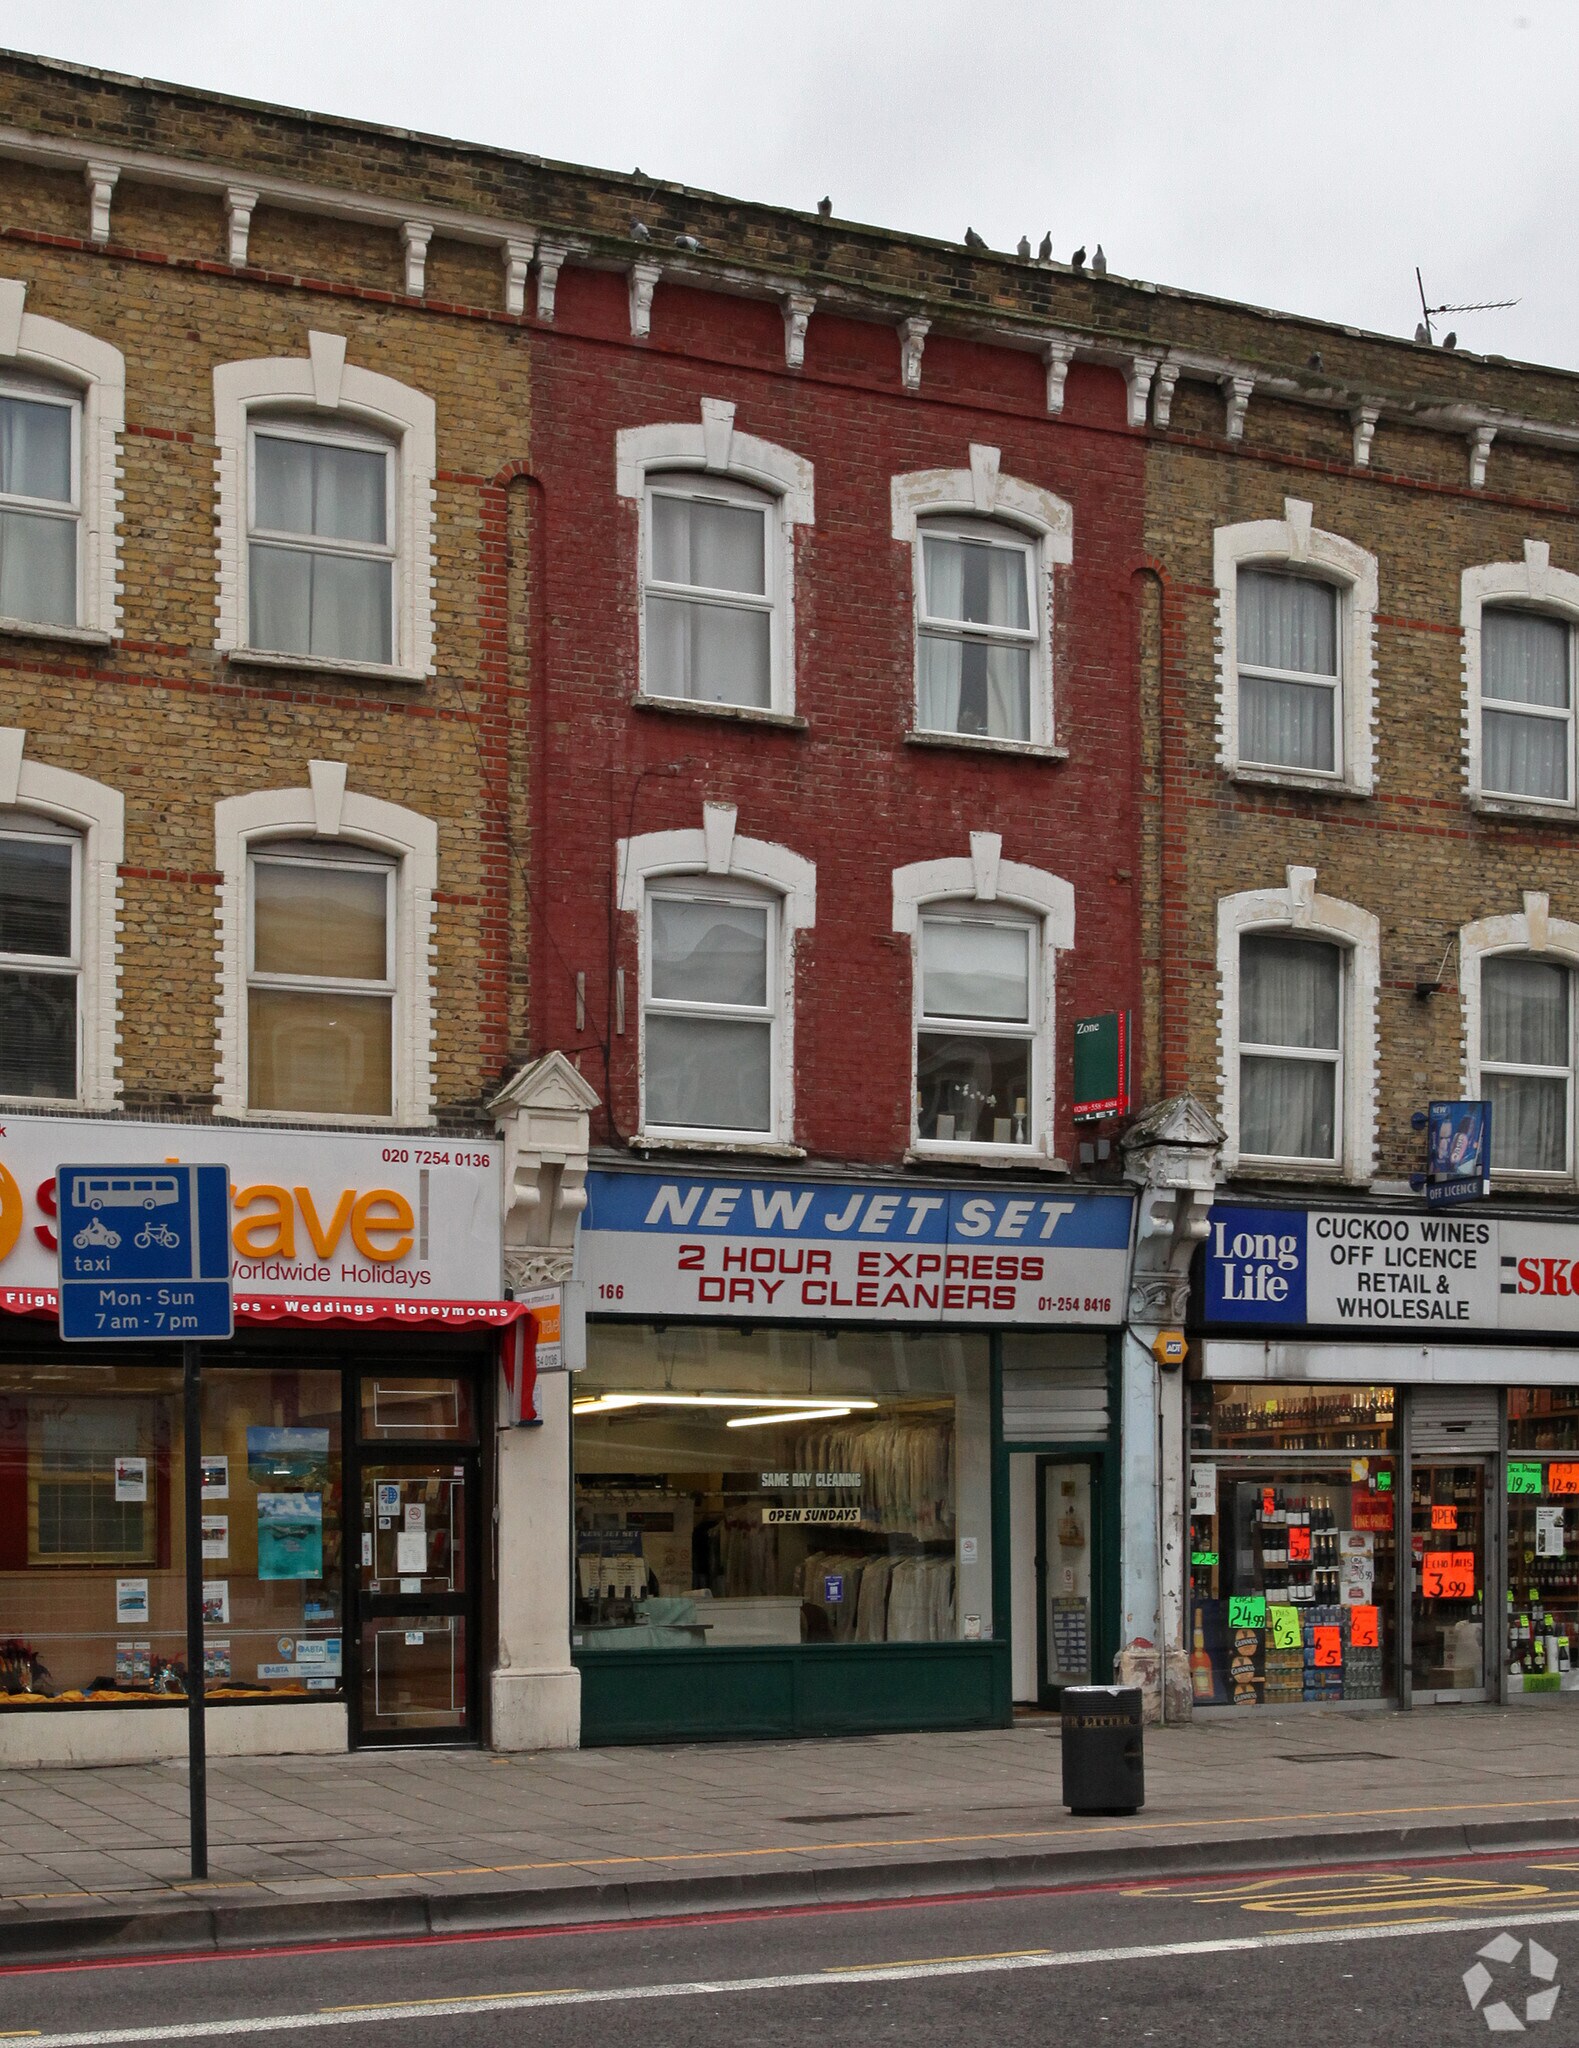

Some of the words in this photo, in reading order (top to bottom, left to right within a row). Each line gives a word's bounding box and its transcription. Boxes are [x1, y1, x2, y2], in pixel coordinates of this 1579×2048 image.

[1076, 1023, 1100, 1034] Zone
[1086, 1110, 1116, 1120] LET
[382, 1149, 409, 1163] 020
[415, 1150, 450, 1165] 7254
[455, 1154, 490, 1168] 0136
[1430, 1188, 1442, 1200] OFF
[1444, 1182, 1477, 1197] LICENCE
[644, 1184, 816, 1230] NEW
[825, 1194, 940, 1235] JET
[954, 1199, 1076, 1240] SET
[1316, 1218, 1409, 1242] CUCKOO
[1420, 1222, 1490, 1244] WINES
[1212, 1222, 1298, 1271] Long
[74, 1256, 111, 1272] taxi
[677, 1245, 705, 1270] 2
[722, 1246, 832, 1276] HOUR
[858, 1252, 1044, 1281] EXPRESS
[1330, 1244, 1373, 1267] OFF
[1384, 1247, 1477, 1270] LICENCE
[231, 1261, 331, 1282] orldwide
[341, 1265, 431, 1288] Holidays
[1222, 1262, 1288, 1302] Life
[1358, 1272, 1430, 1294] RETAIL
[1436, 1274, 1450, 1294] &
[100, 1290, 141, 1306] Mon
[158, 1290, 194, 1306] Sun
[598, 1284, 624, 1300] 166
[698, 1276, 784, 1304] DRY
[801, 1280, 1016, 1310] CLEANERS
[6, 1292, 57, 1307] Fligh
[285, 1302, 374, 1315] Weddings
[396, 1304, 508, 1318] Honeymoons
[1038, 1296, 1080, 1312] 01-254
[1084, 1298, 1111, 1313] 8416
[1338, 1297, 1470, 1320] WHOLESALE
[1167, 1344, 1182, 1352] ADT
[762, 1472, 789, 1487] SAME
[792, 1472, 812, 1487] DAY
[816, 1472, 861, 1487] CLEANING
[768, 1510, 800, 1522] OPEN
[804, 1510, 858, 1521] SUNDAYS
[1432, 1509, 1457, 1524] OPEN
[1429, 1572, 1466, 1597] 3.99
[1231, 1606, 1264, 1627] 24.99
[1234, 1638, 1258, 1648] GUINNESS
[1230, 1665, 1255, 1675] GUINNESS
[1234, 1692, 1257, 1701] GUINNESS
